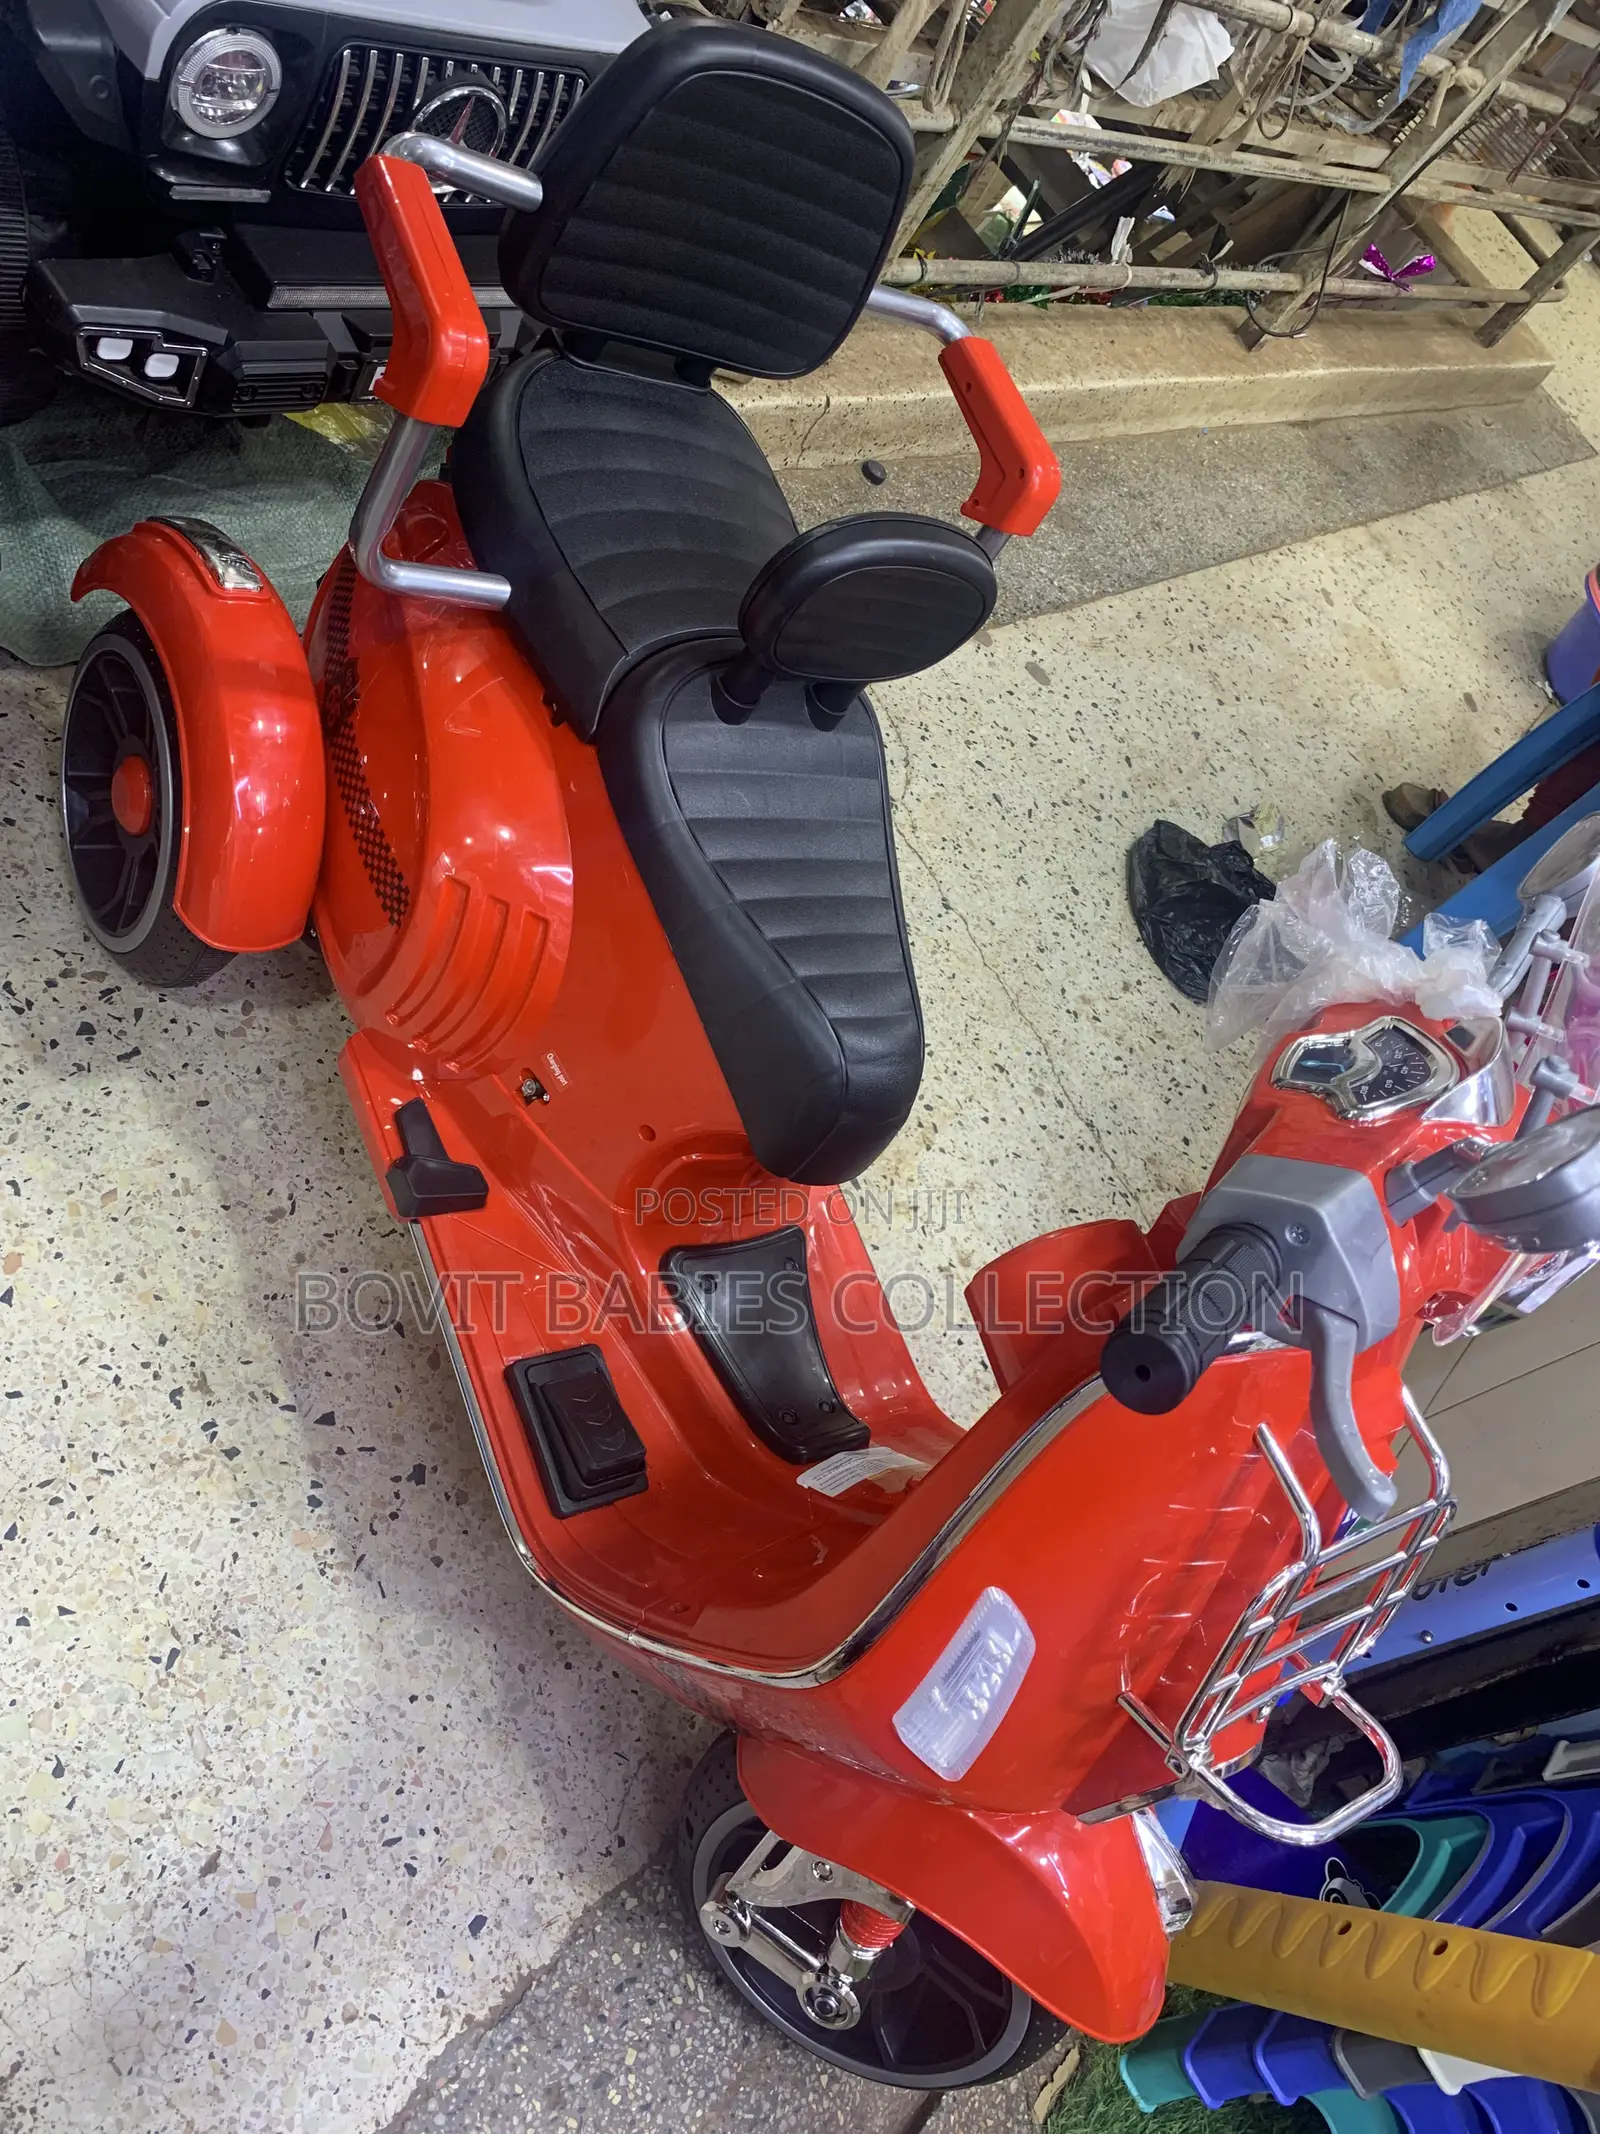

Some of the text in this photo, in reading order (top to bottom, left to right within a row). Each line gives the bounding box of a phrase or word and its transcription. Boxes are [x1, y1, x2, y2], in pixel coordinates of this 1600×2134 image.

[547, 1053, 568, 1086] Charging port
[1401, 1066, 1409, 1074] 40
[1385, 1080, 1393, 1088] 60
